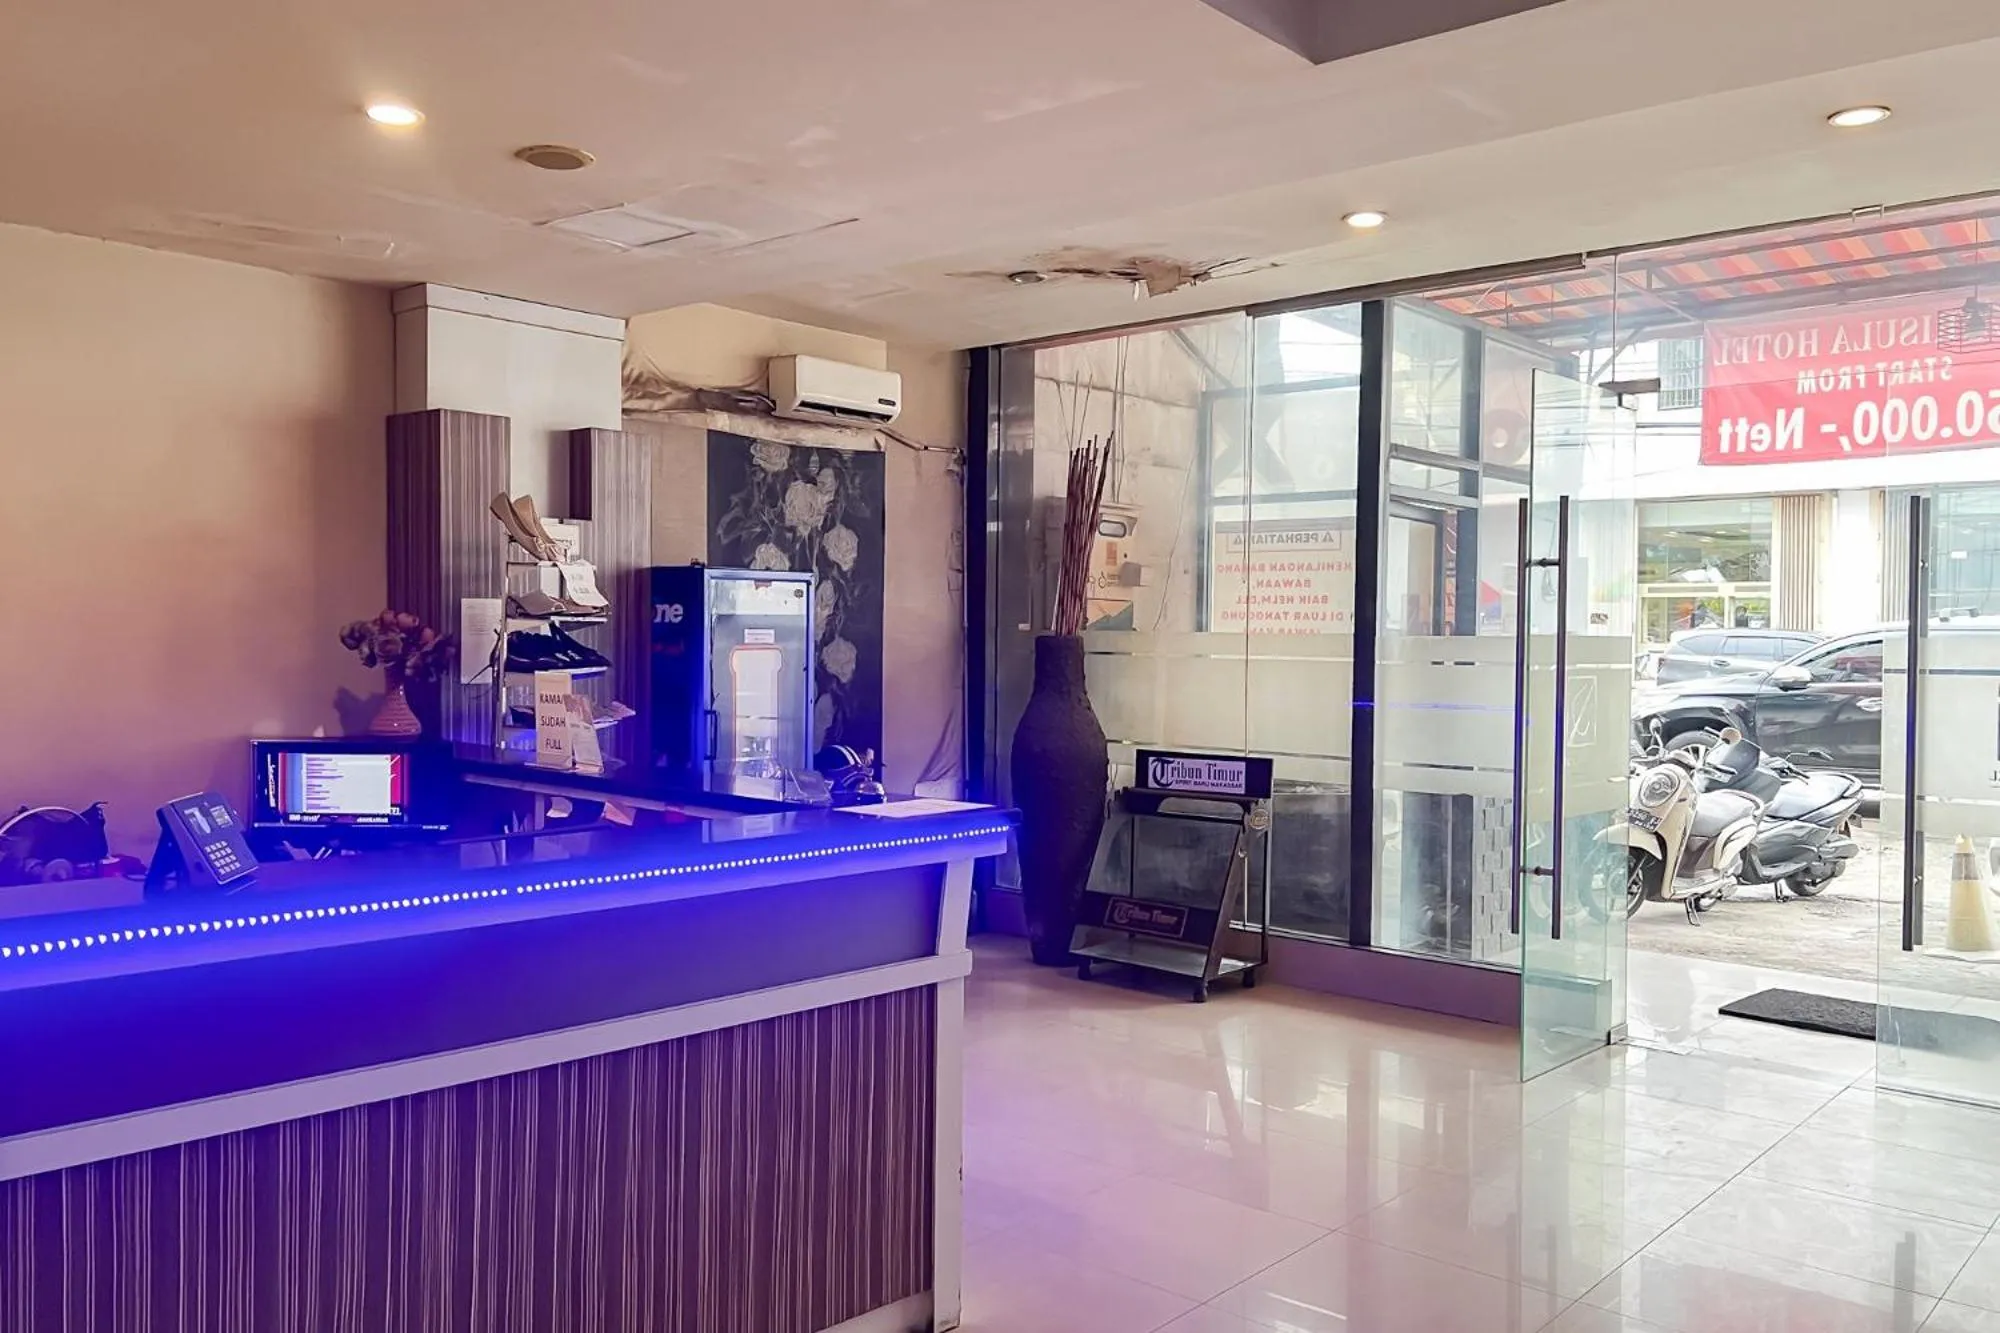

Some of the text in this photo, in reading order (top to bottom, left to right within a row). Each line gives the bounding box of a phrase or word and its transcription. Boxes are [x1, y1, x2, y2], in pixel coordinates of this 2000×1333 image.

[540, 693, 564, 705] KAMA
[541, 715, 566, 727] SUDAH
[545, 738, 562, 750] FULL
[1151, 757, 1243, 787] Tribun Timur
